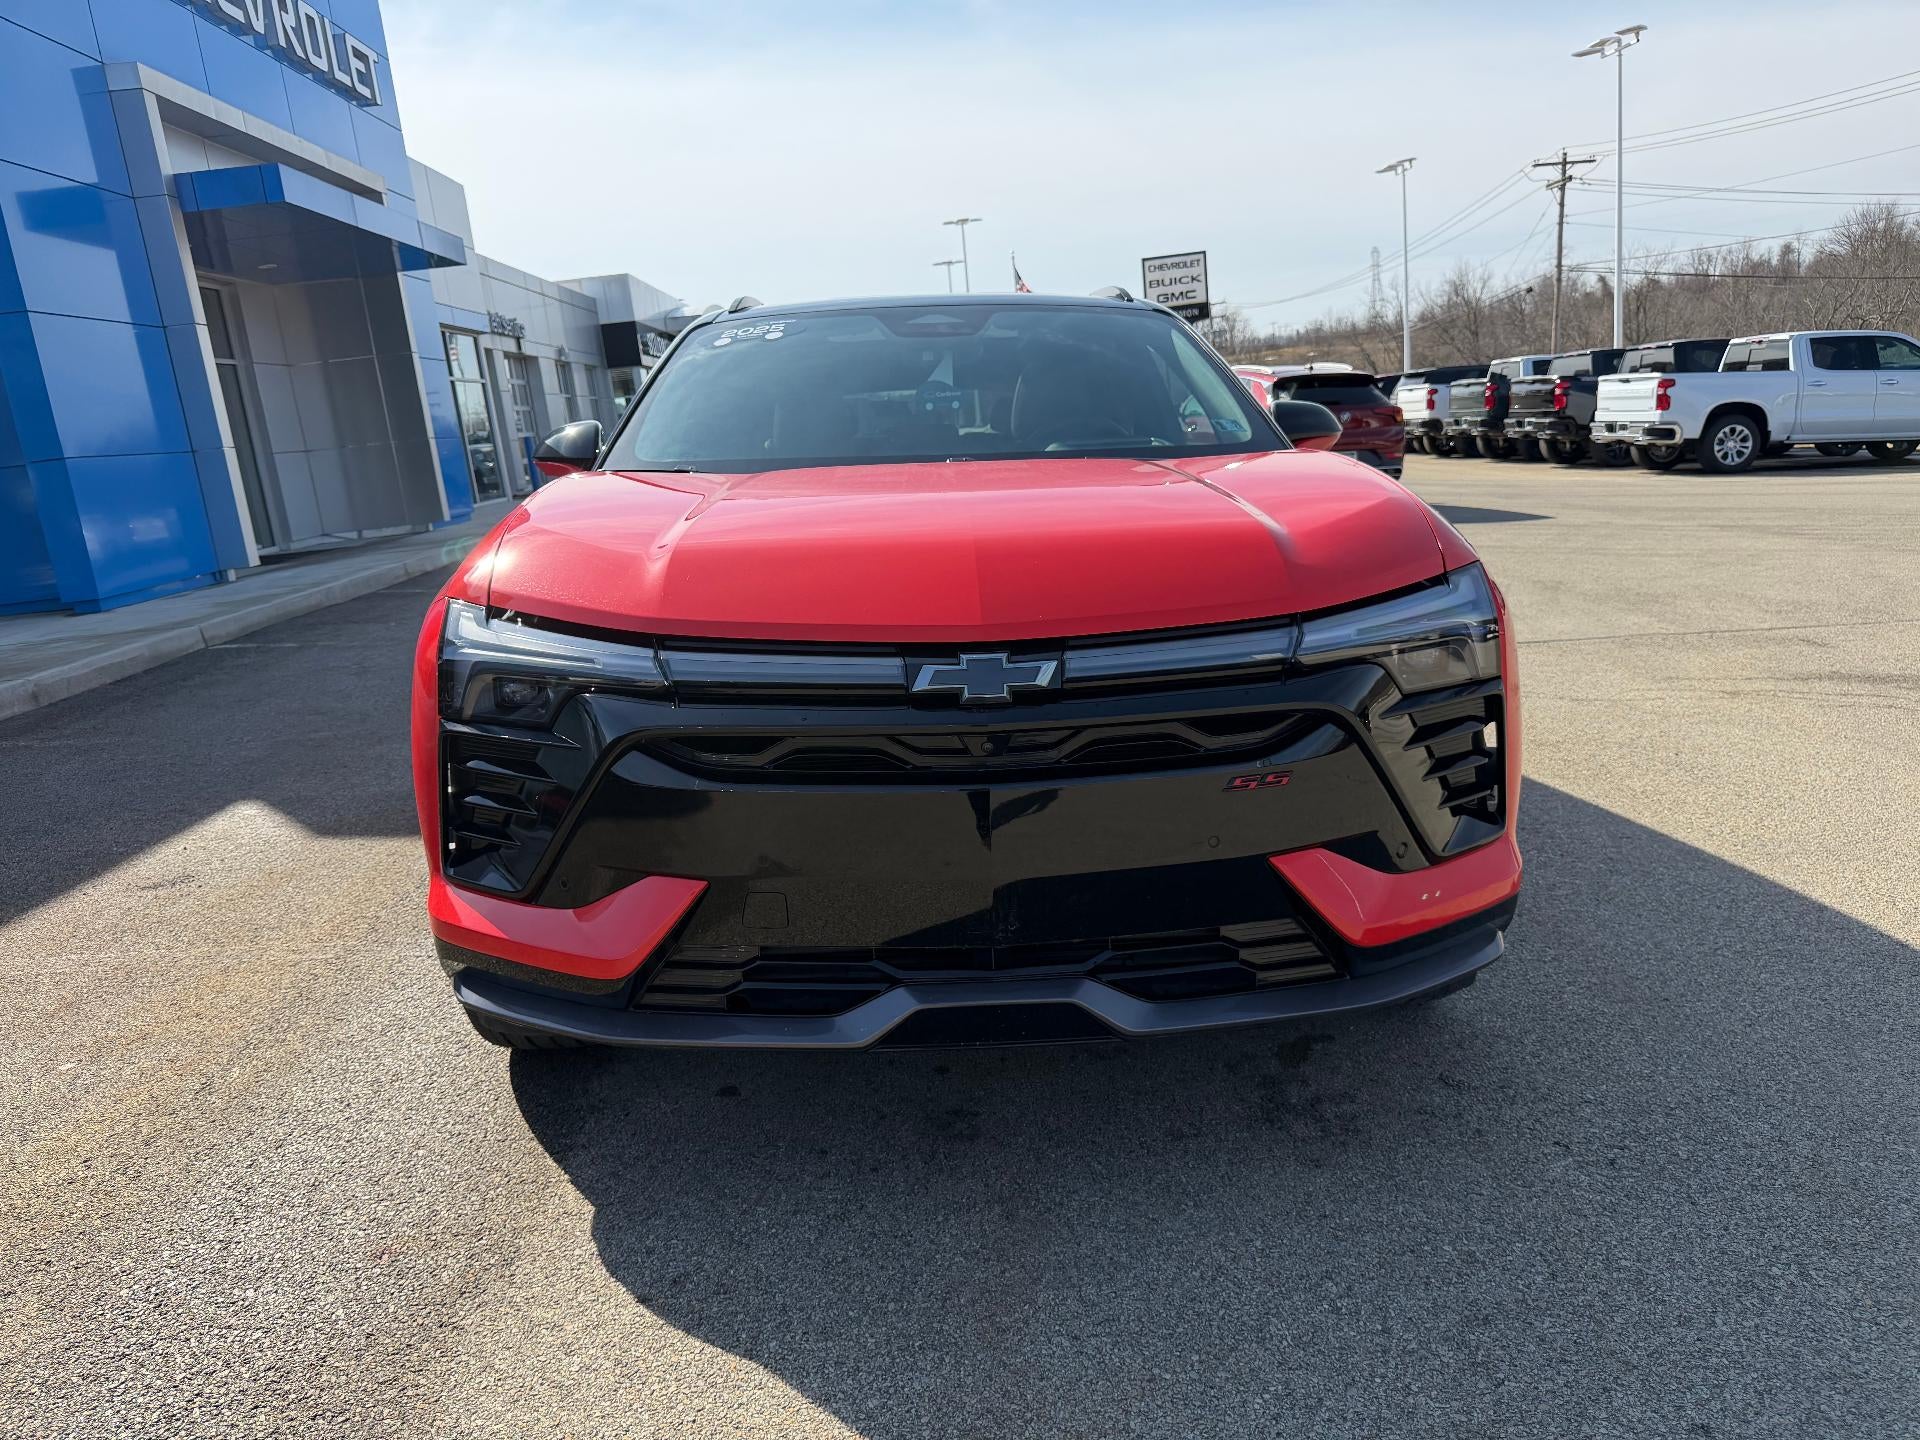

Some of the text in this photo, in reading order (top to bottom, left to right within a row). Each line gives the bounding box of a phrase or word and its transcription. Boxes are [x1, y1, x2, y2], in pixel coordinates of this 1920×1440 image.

[1147, 258, 1201, 273] CHEVROLET
[1148, 274, 1202, 289] BUICK
[1156, 289, 1197, 304] GMC
[721, 323, 786, 338] 2025
[1223, 770, 1294, 792] SS
